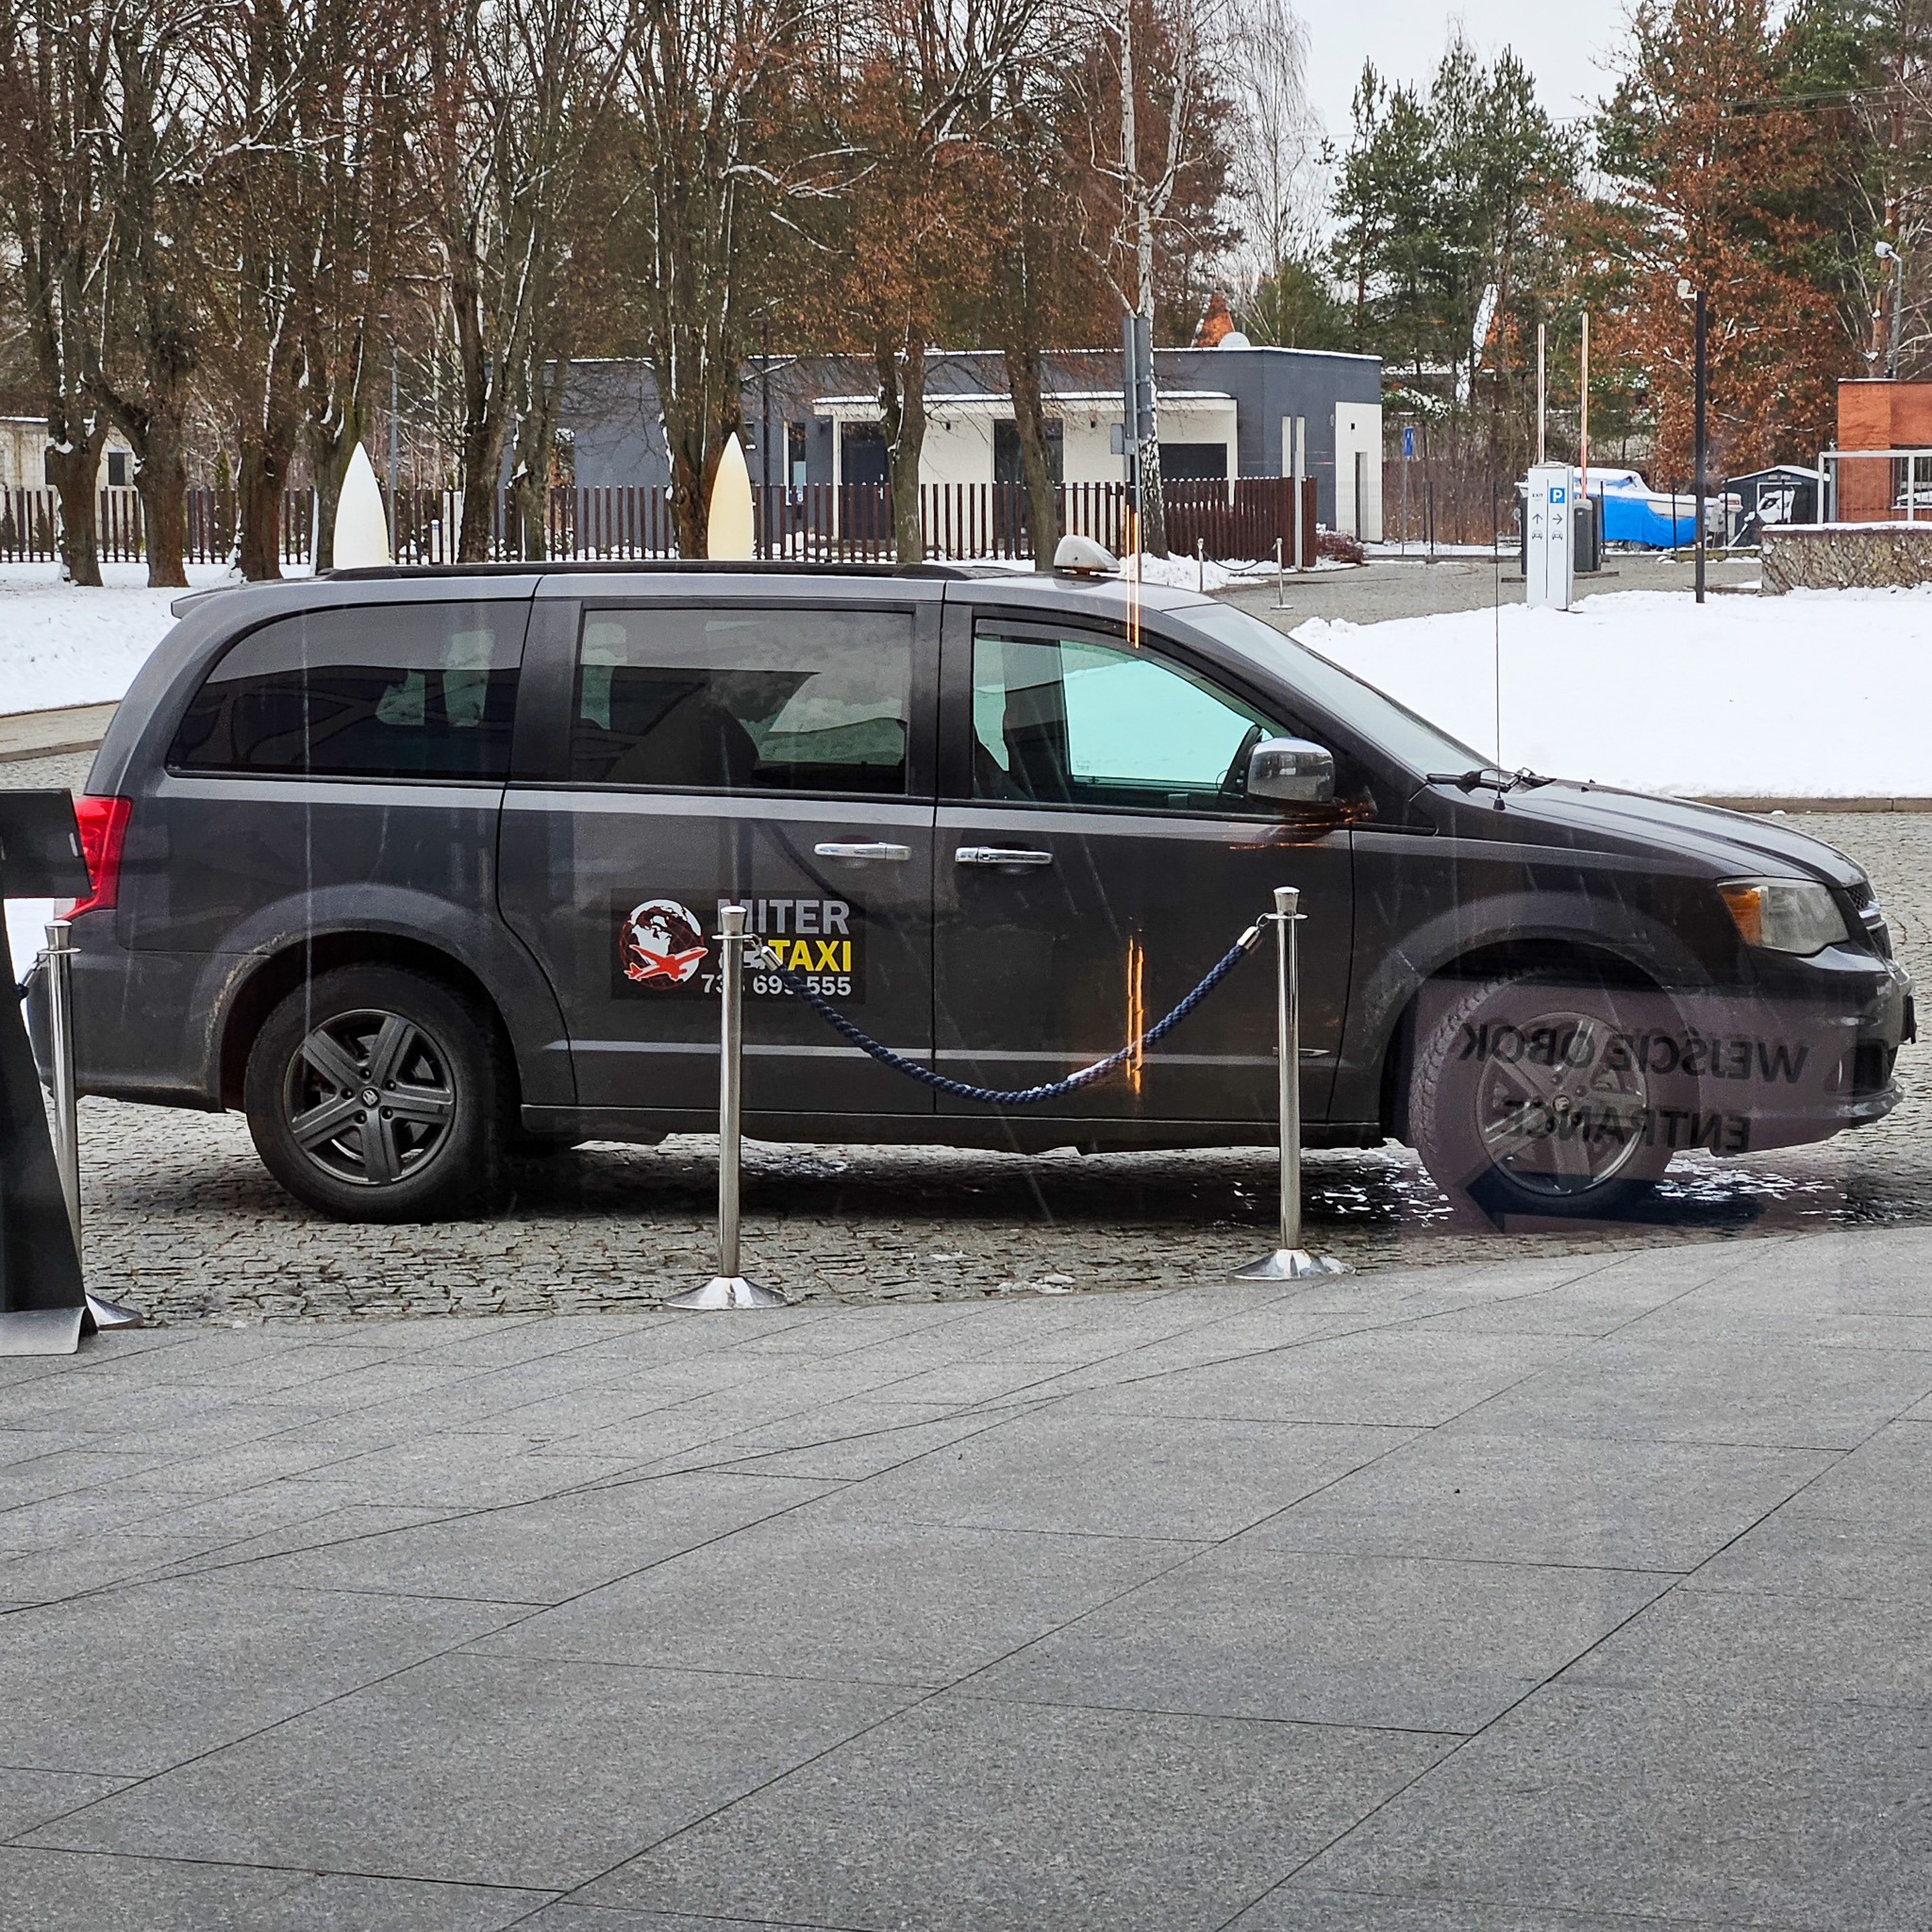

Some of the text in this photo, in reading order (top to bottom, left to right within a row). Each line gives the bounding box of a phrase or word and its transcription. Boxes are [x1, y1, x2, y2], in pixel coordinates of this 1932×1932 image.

[1553, 489, 1563, 503] P
[717, 899, 849, 934] MITER
[768, 940, 851, 973] TAXI
[701, 974, 745, 993] 73
[807, 975, 852, 996] 555
